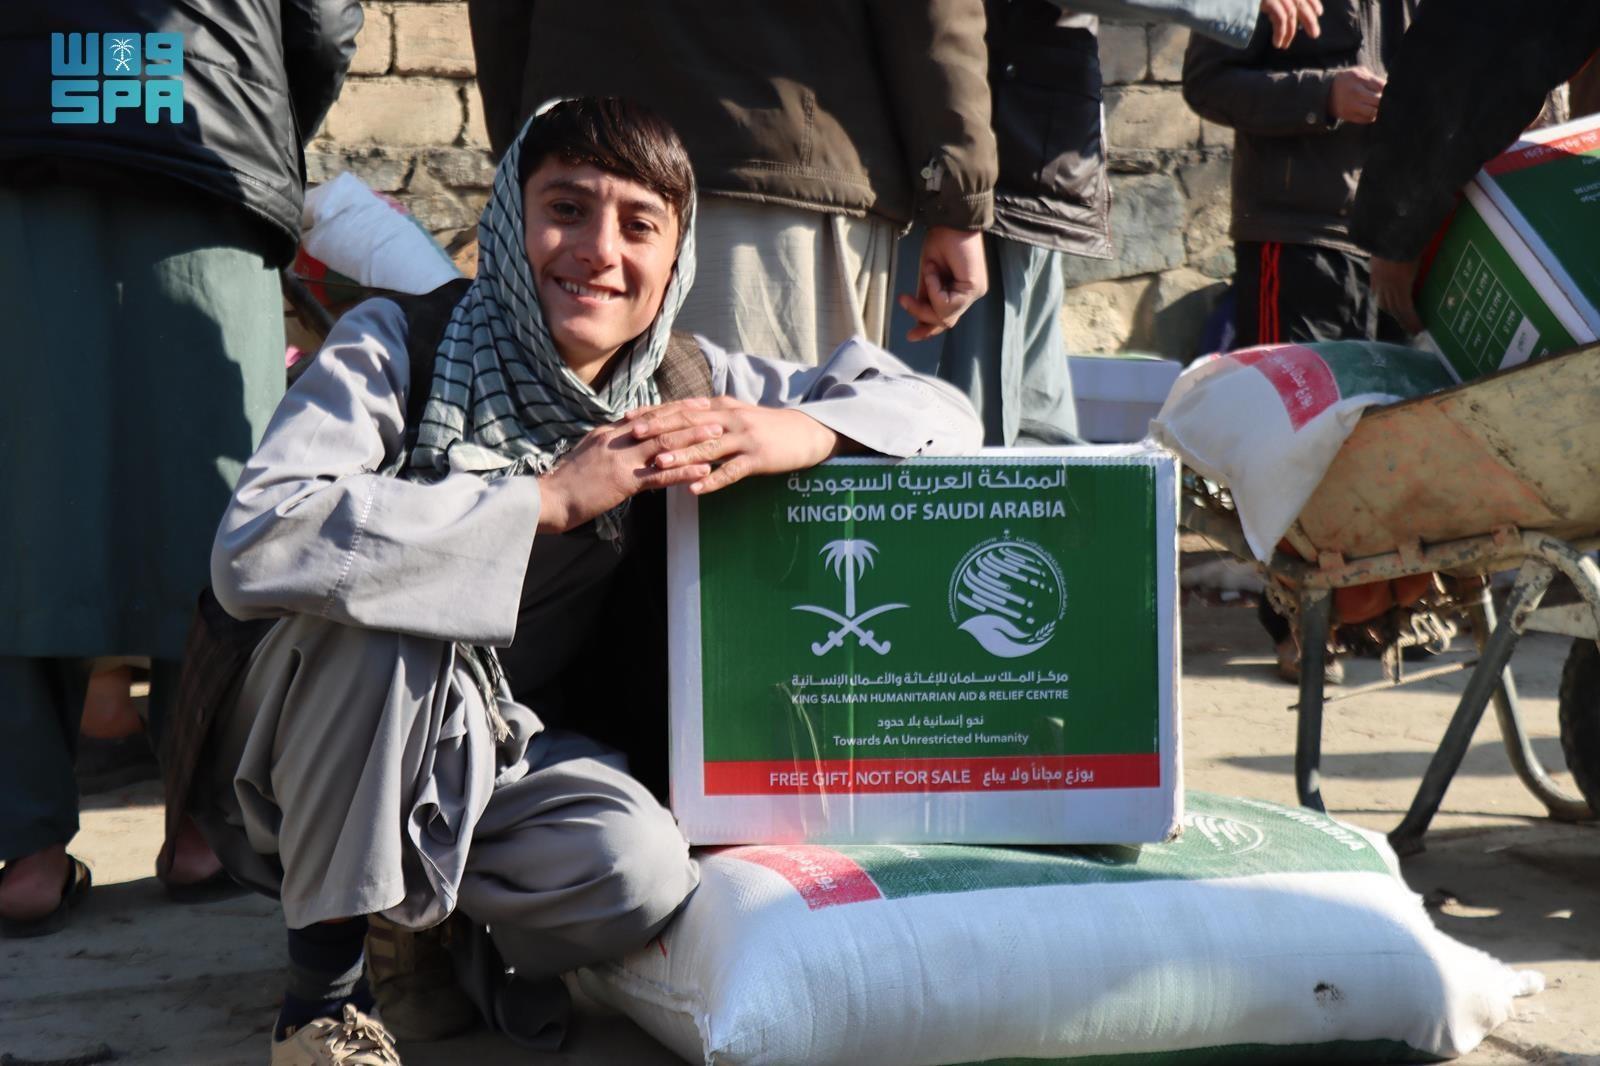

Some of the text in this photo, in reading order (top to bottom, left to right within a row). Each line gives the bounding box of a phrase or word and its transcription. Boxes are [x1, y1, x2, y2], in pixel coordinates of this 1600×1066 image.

[787, 468, 1066, 498] المملكة العربية السعودية
[787, 500, 1066, 523] KINGDOM OF SAUDI ARABIA
[949, 672, 997, 686] سلمان
[997, 671, 1035, 684] الملك
[1036, 670, 1069, 685] مركز
[791, 689, 1069, 705] KING SALMAN HUMANITARIAN AID & RELIEF CENTRE
[877, 714, 985, 730] نحو إنسانية بلا حدود
[833, 732, 1030, 747] Towards An Unrestricted Humanity
[769, 769, 971, 788] FREE GIFT, NOT FOR SALE
[982, 767, 1007, 787] يباع
[1009, 766, 1029, 784] ولا
[1065, 766, 1095, 785] يوزع
